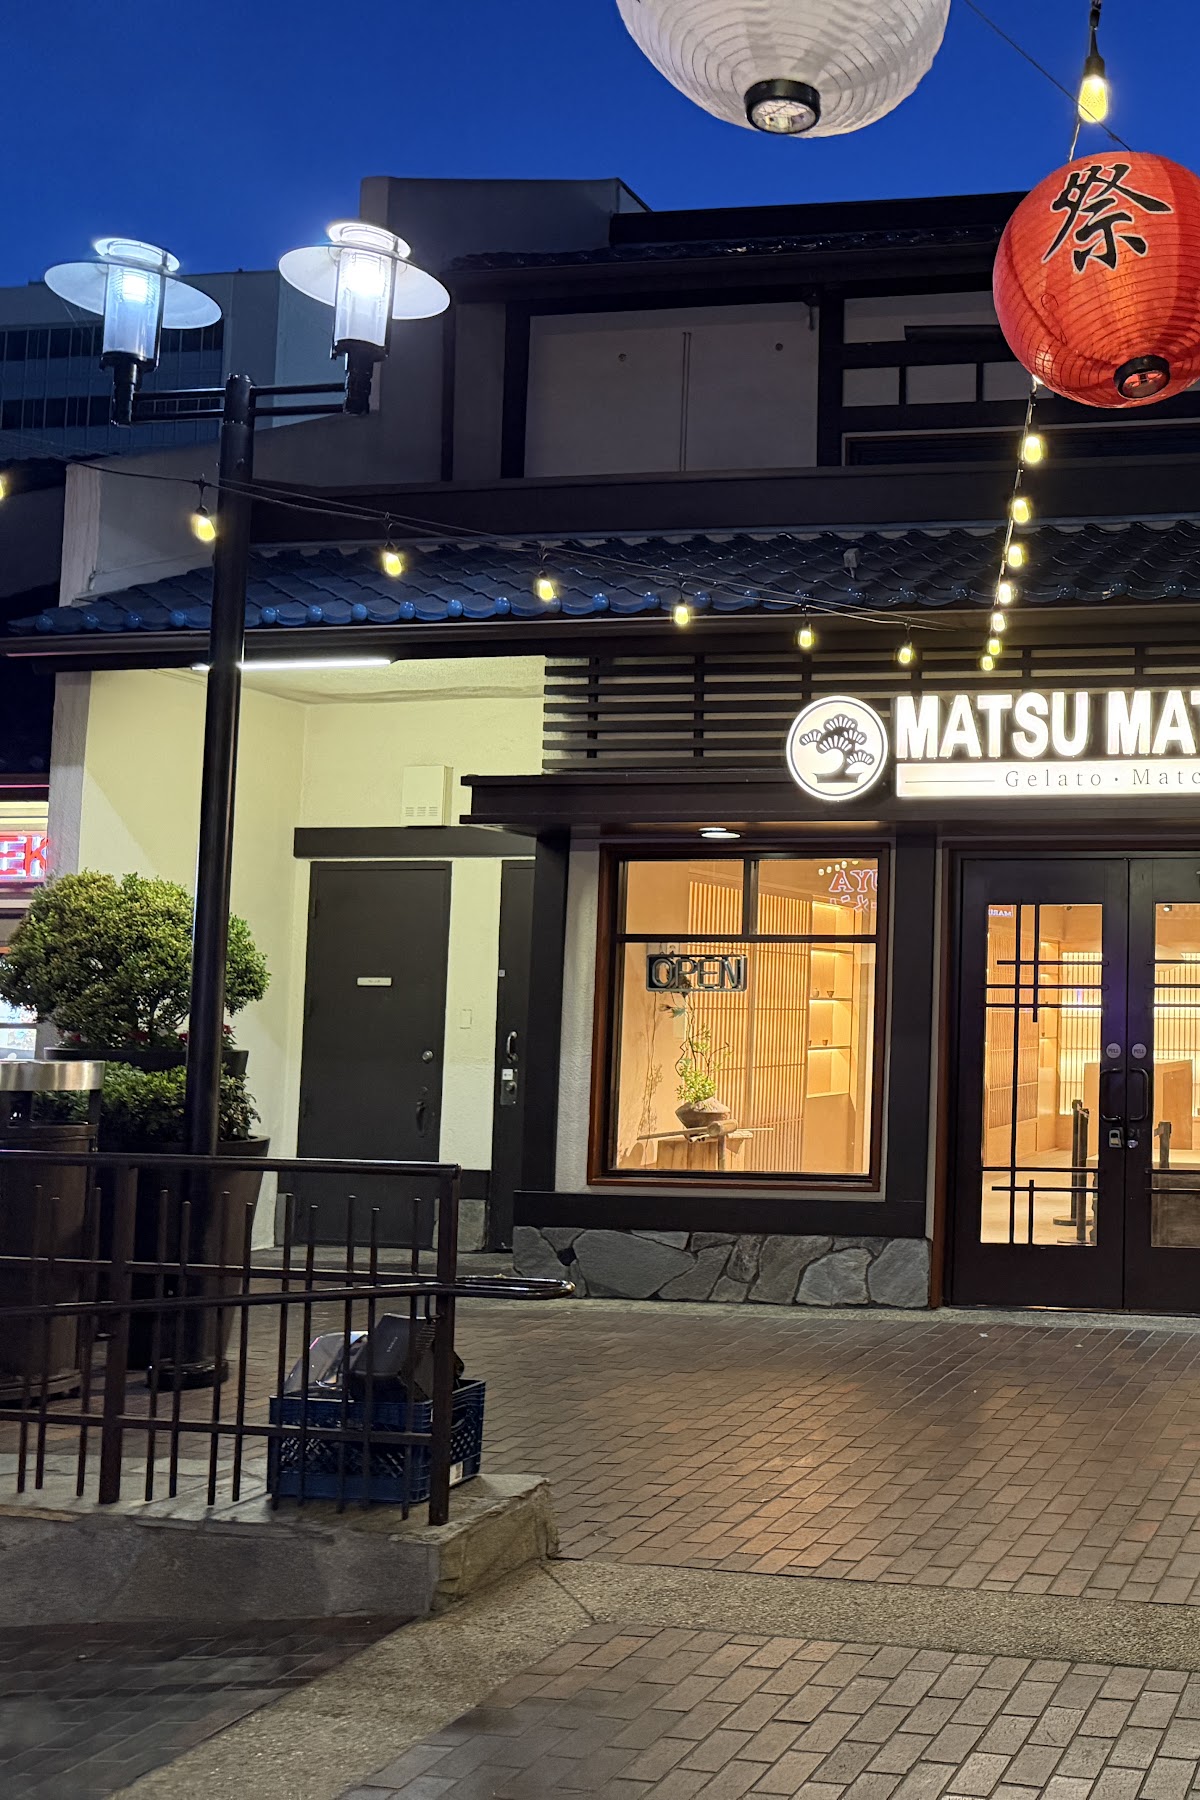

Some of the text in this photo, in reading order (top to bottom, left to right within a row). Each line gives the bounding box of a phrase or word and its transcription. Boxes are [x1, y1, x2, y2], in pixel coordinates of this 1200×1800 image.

[1042, 163, 1172, 274] 祭
[896, 691, 1089, 759] MATSU
[1005, 770, 1103, 788] Gelato
[651, 957, 742, 988] OPEN
